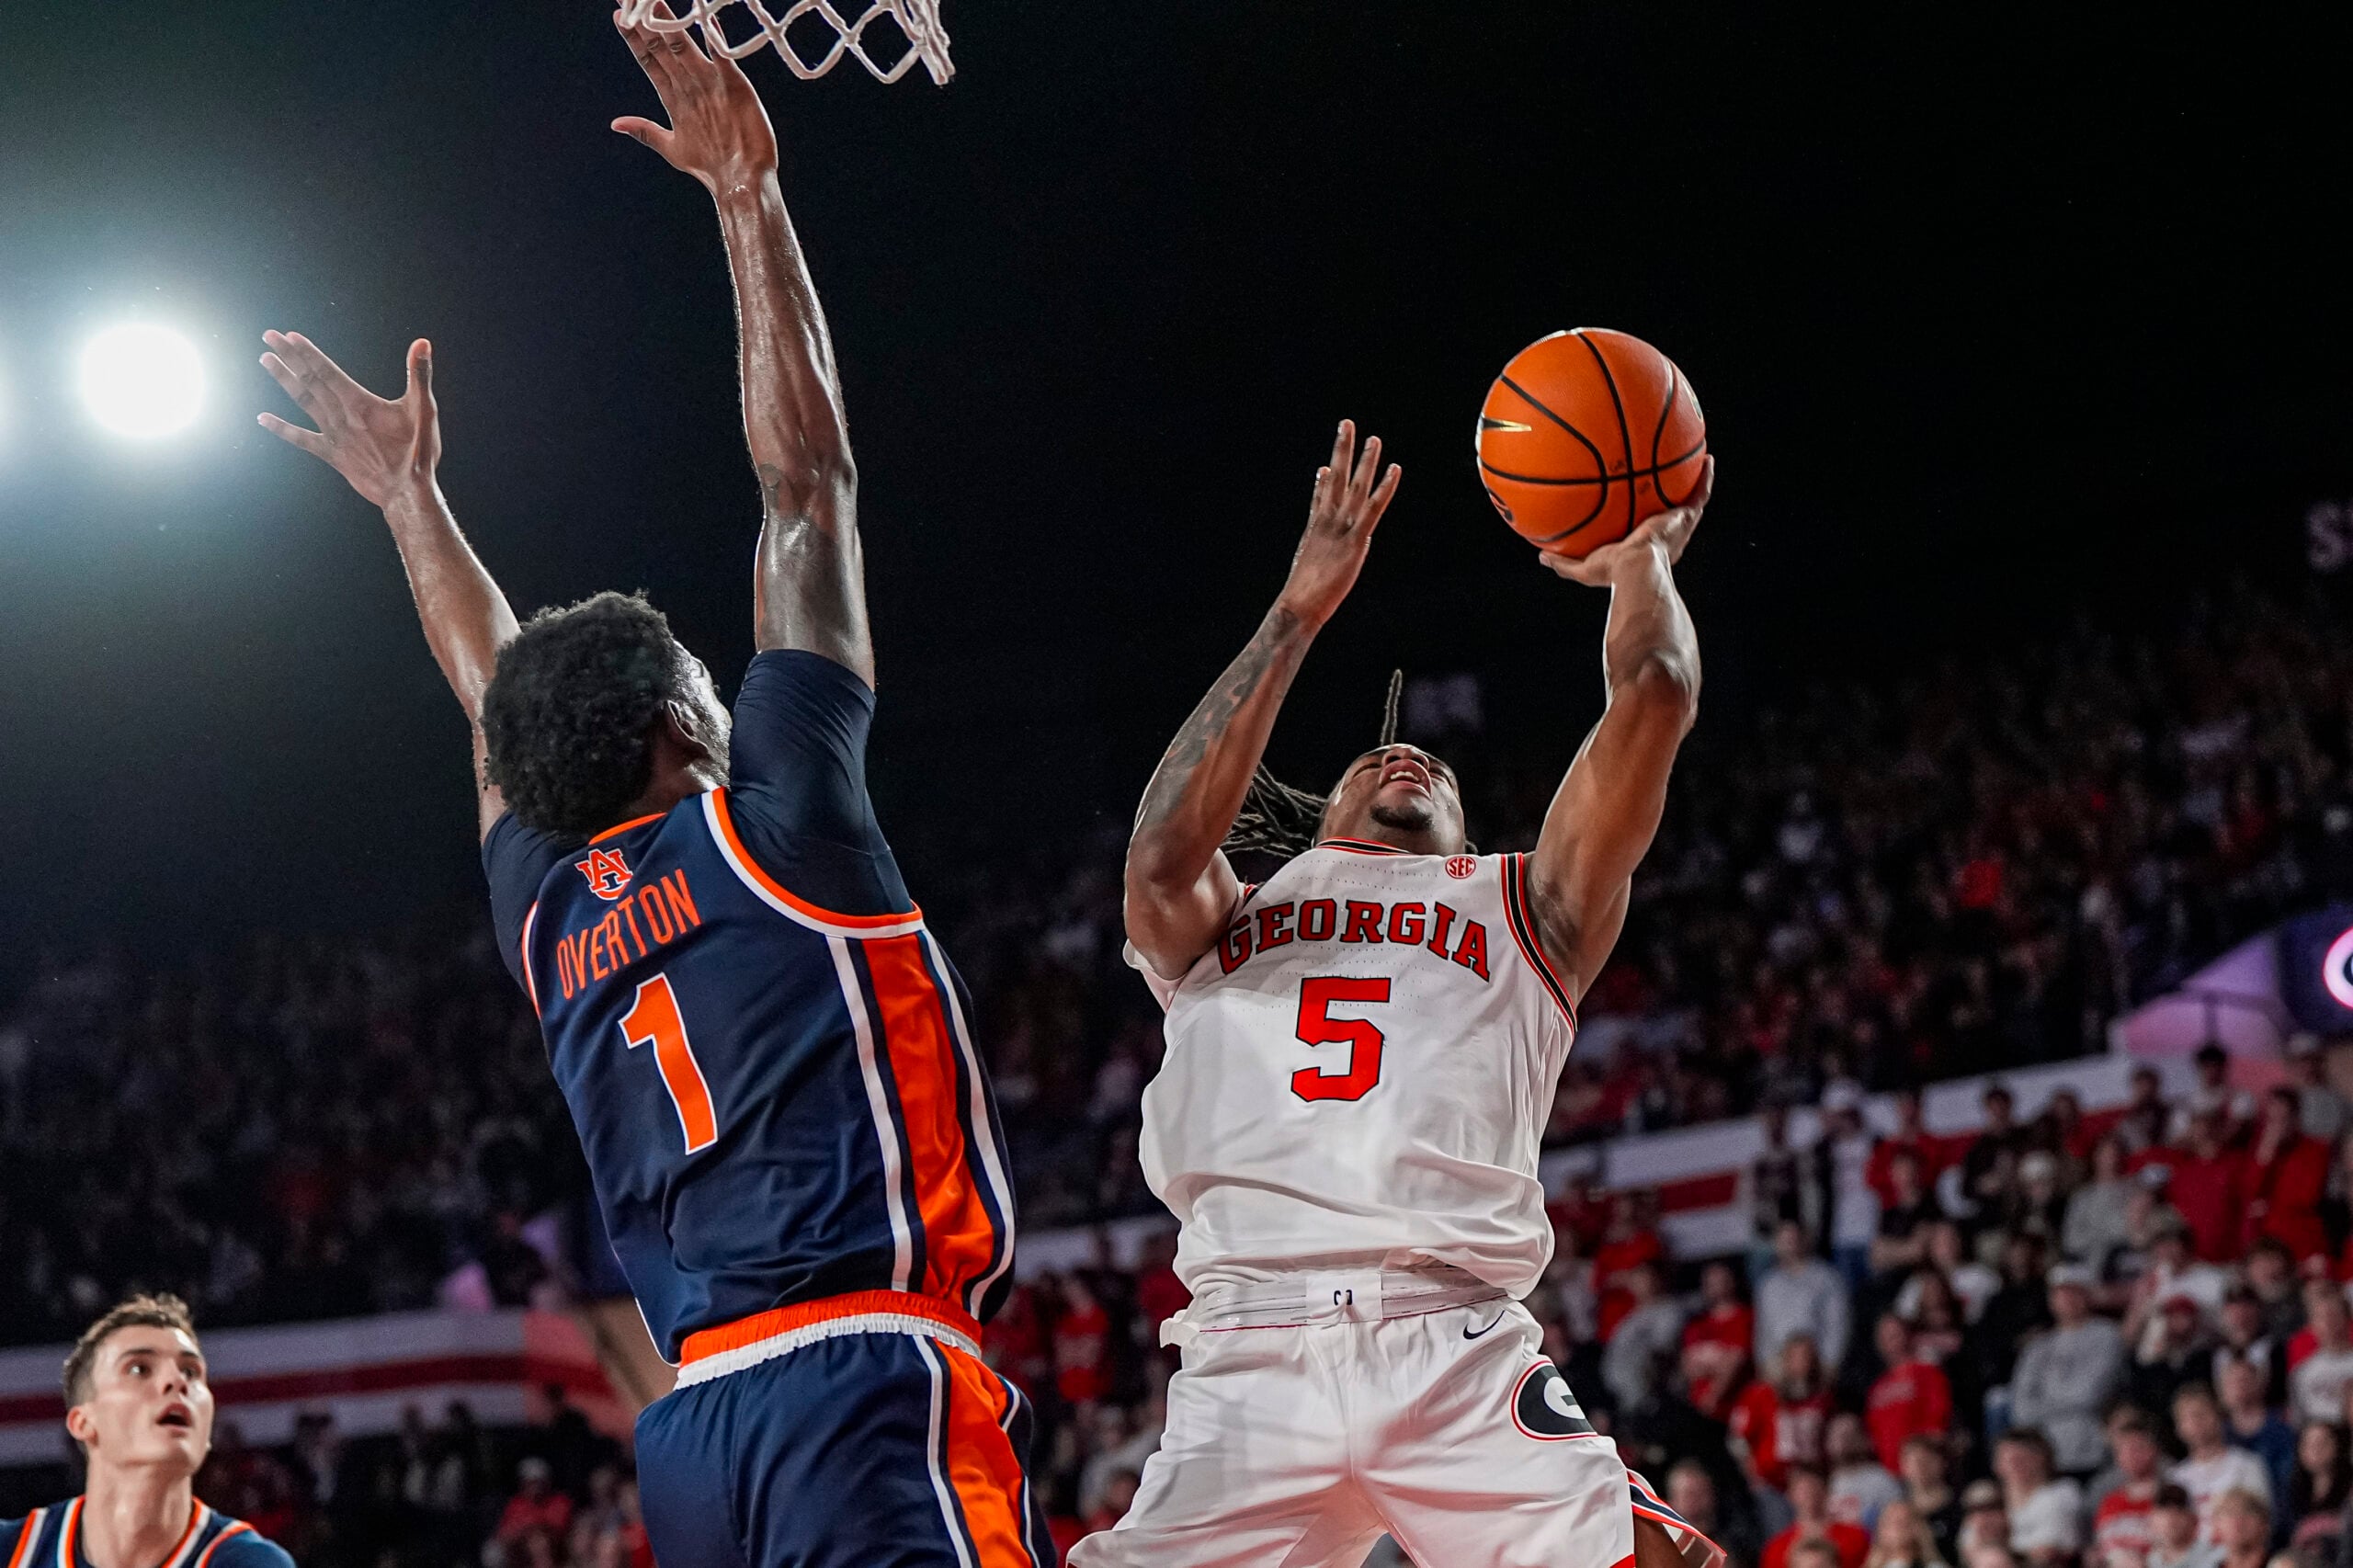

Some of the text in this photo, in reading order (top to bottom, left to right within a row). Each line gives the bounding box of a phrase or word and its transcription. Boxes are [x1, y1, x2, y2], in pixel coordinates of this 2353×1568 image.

[1448, 857, 1473, 877] SEC
[556, 869, 701, 999] OVERTON
[1217, 898, 1489, 982] GEORGIA
[619, 972, 718, 1154] 1
[1290, 977, 1391, 1102] 5
